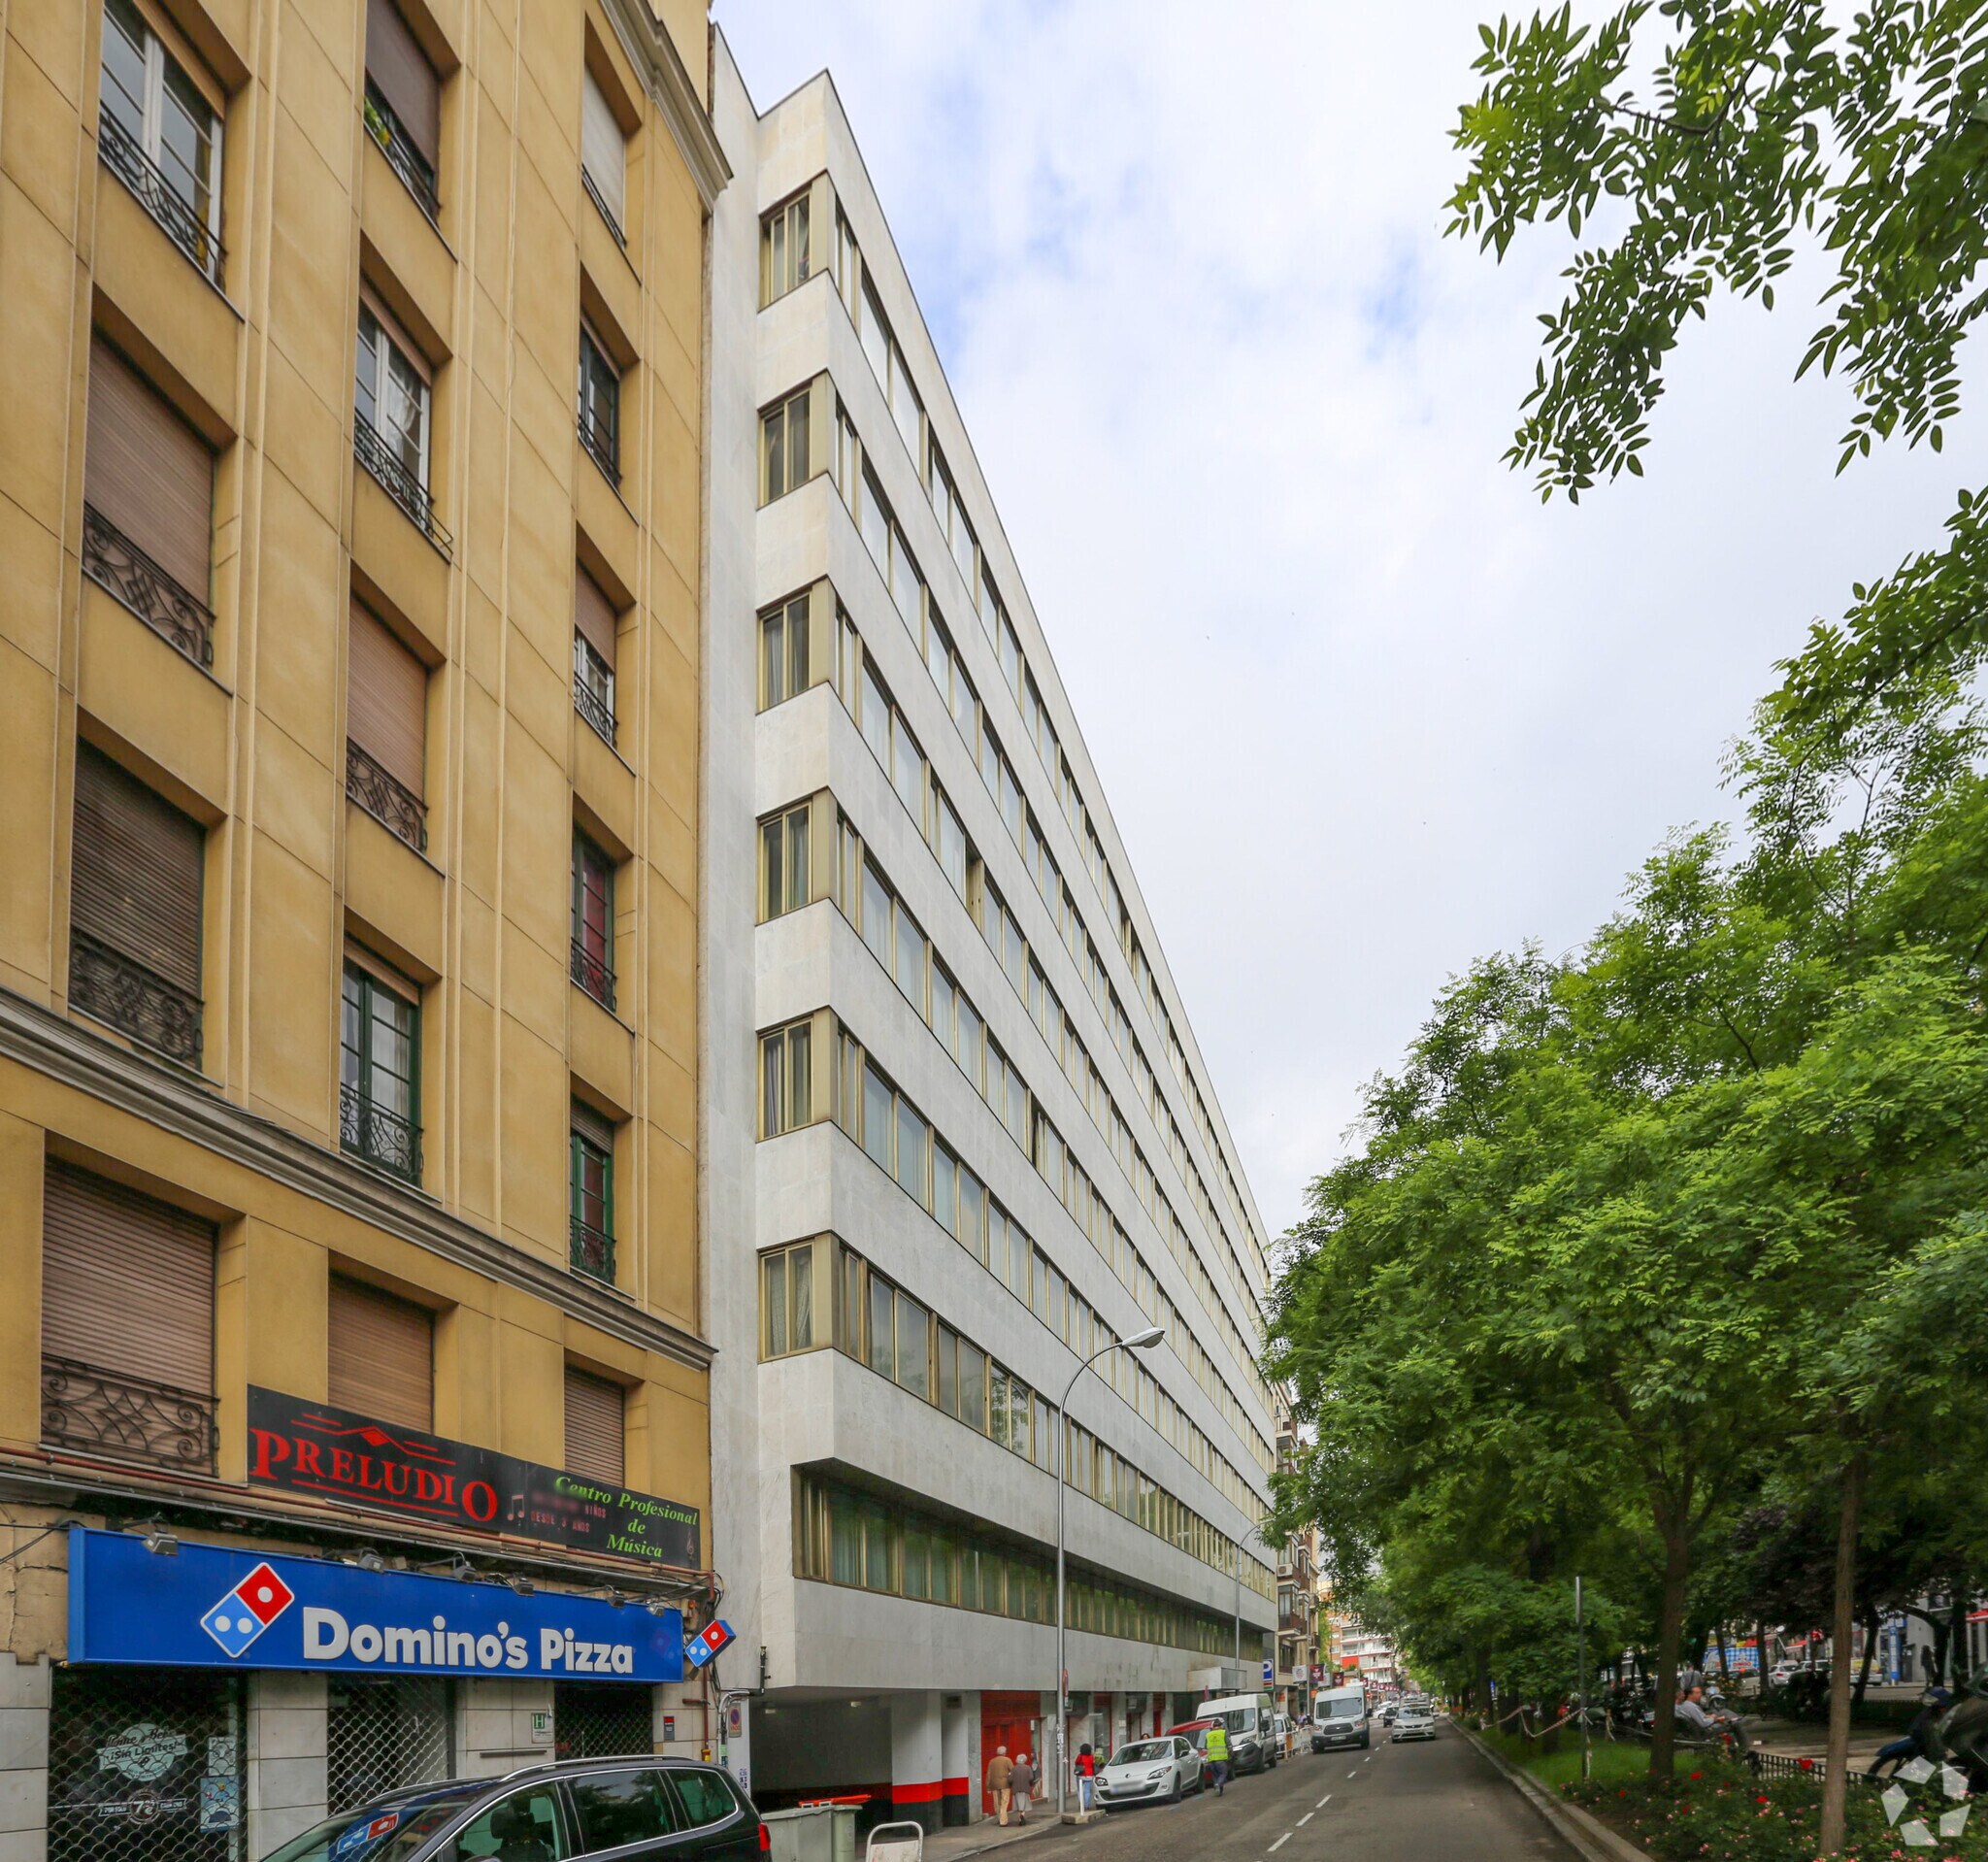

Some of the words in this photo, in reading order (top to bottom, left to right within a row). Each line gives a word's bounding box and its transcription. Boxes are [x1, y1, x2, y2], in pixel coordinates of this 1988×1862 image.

[249, 1427, 498, 1522] PRELUDIO
[554, 1476, 612, 1504] Centro
[617, 1492, 698, 1525] Profesional
[606, 1533, 663, 1558] Música
[627, 1518, 646, 1534] de
[303, 1607, 529, 1669] Domino's
[541, 1627, 633, 1674] Pizza
